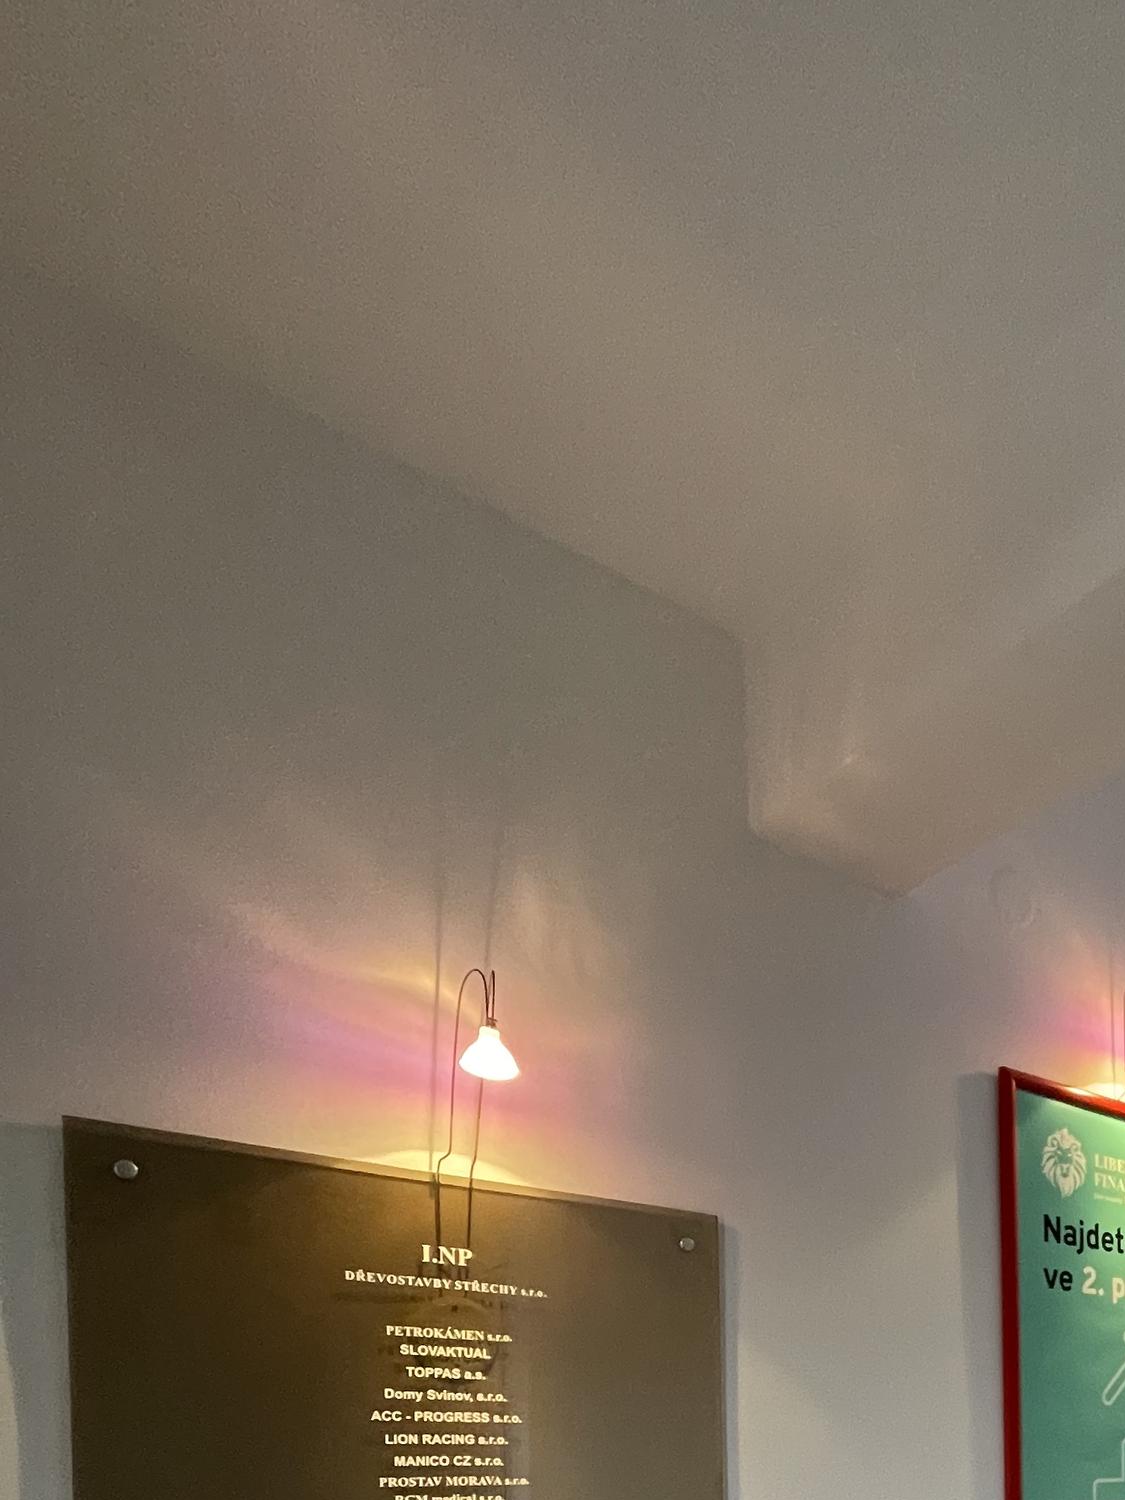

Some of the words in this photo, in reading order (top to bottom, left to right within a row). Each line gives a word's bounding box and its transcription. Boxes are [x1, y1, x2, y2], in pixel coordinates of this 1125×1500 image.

[345, 1269, 452, 1290] DŘEVOSTAVBY
[454, 1279, 517, 1296] STŘECHY
[521, 1288, 548, 1298] s.r.o.
[1043, 1268, 1073, 1291] ve
[1082, 1265, 1104, 1296] 2.
[386, 1325, 484, 1341] PETROKÁMEN
[487, 1333, 513, 1342] s.r.o.
[400, 1344, 492, 1359] SLOVAKTUAL
[406, 1366, 461, 1379] TOPPAS
[463, 1371, 486, 1380] a.s.
[384, 1388, 423, 1402] Domy
[426, 1389, 473, 1402] Svinov,
[476, 1393, 508, 1402] s.r.o.
[371, 1410, 402, 1422] ACC
[414, 1411, 490, 1423] PROGRESS
[493, 1414, 522, 1424] s.r.o.
[385, 1434, 418, 1445] LION
[422, 1434, 475, 1445] RACING
[477, 1436, 509, 1445] s.r.o.
[394, 1456, 450, 1467] MANICO
[453, 1456, 471, 1466] CZ
[474, 1457, 504, 1467] s.r.o.
[379, 1476, 442, 1487] PROSTAV
[445, 1475, 502, 1486] MORAVA
[504, 1477, 529, 1485] s.r.o.
